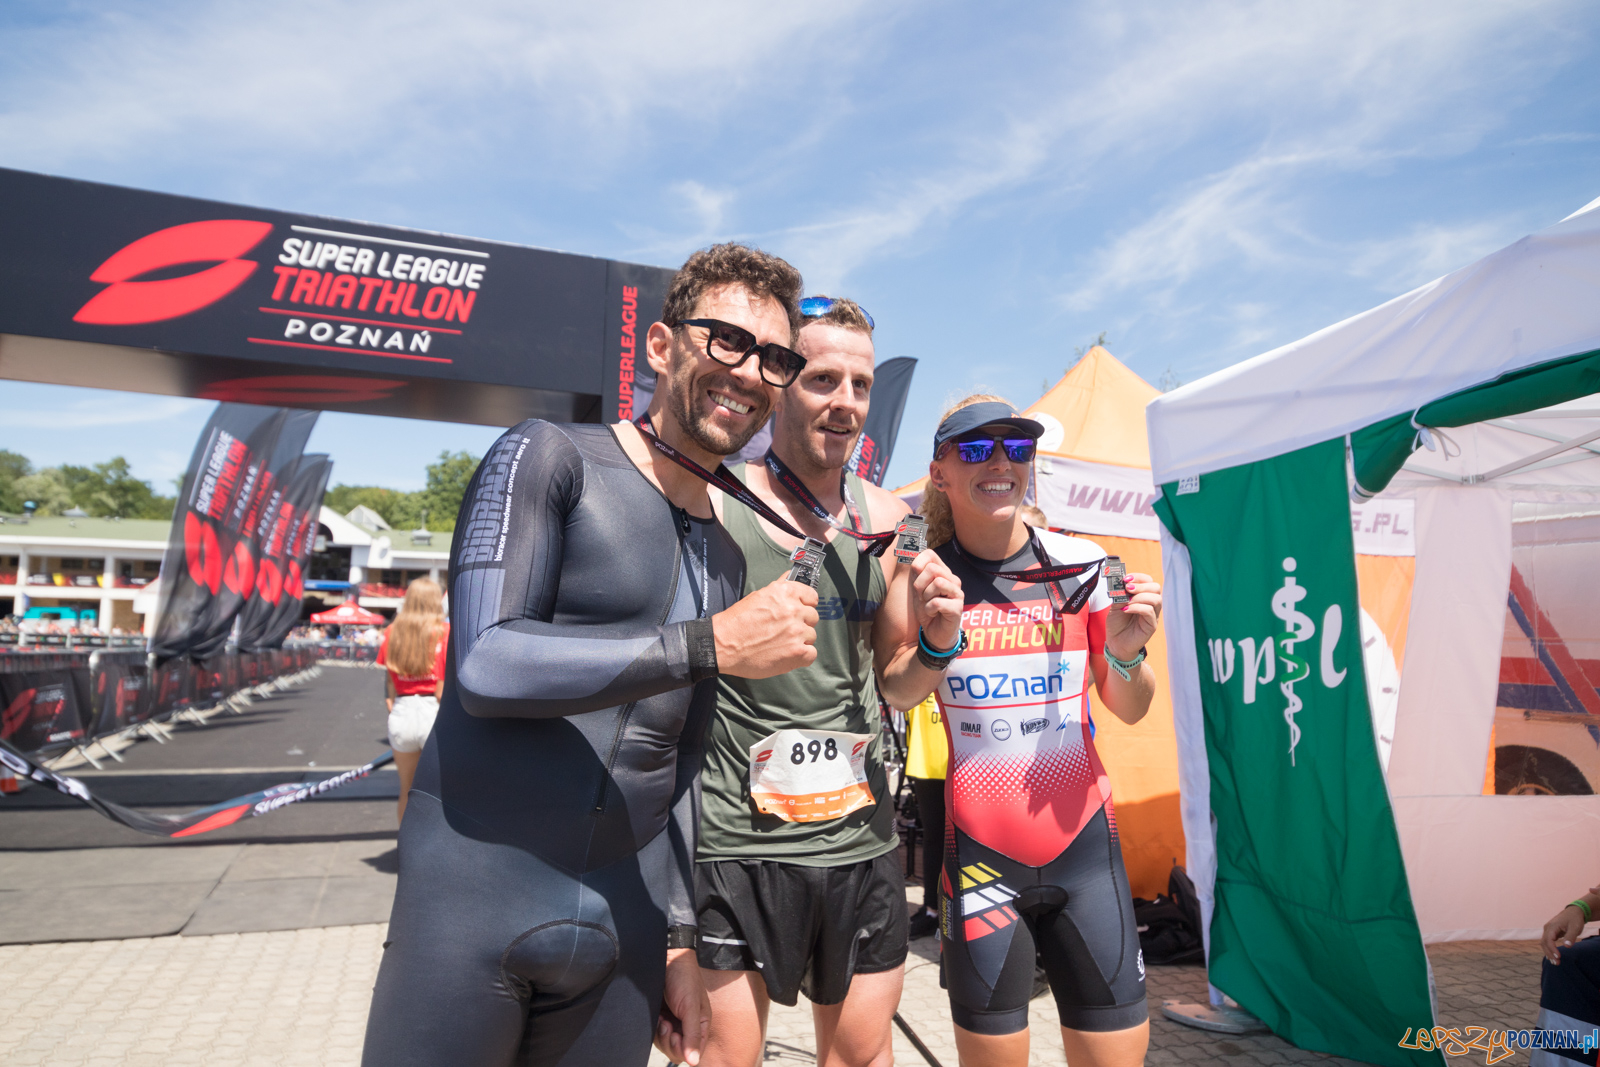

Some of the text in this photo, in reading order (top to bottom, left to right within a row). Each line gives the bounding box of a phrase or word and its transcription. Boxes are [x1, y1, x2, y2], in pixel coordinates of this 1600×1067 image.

[278, 237, 487, 290] SUPER LEAGUE
[271, 265, 478, 323] TRIATHLON
[283, 317, 433, 354] POZNAŃ
[618, 285, 638, 421] SUPERLEAGUE
[514, 442, 527, 461] aero
[195, 429, 234, 516] SUPER LEAGUE
[206, 437, 249, 521] TRIATHLON
[506, 460, 520, 494] concept
[501, 493, 513, 535] speedwear
[493, 534, 507, 563] bioracer
[960, 609, 993, 628] PER
[790, 737, 838, 765] 898
